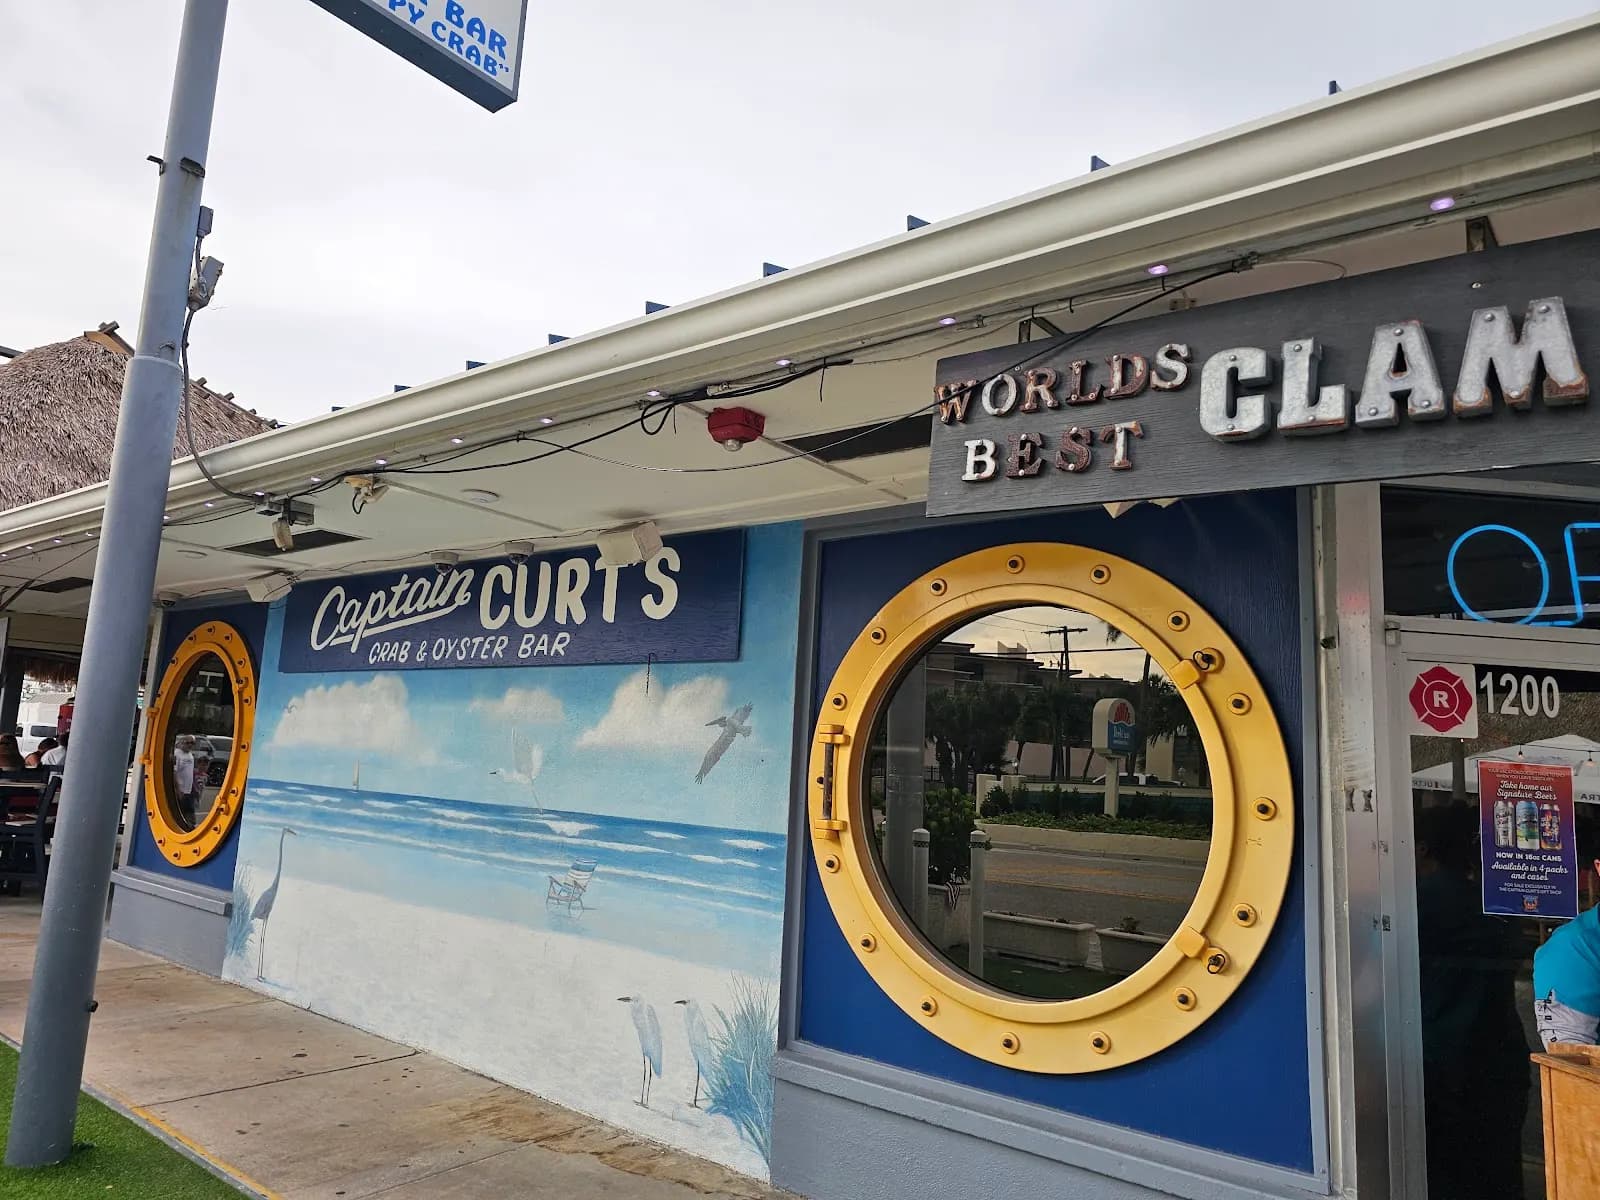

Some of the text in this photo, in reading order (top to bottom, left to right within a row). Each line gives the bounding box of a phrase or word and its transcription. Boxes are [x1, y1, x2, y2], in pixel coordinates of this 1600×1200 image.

[445, 0, 507, 60] BAR
[934, 296, 1590, 442] WORLDS CLAM
[961, 421, 1145, 482] BEST
[310, 546, 682, 654] Captain CURTS
[368, 631, 572, 665] CRAB & OYSTER BAR
[1433, 690, 1449, 708] R
[1480, 671, 1560, 718] 1200
[1497, 788, 1557, 800] Signature Beers
[1500, 780, 1518, 789] Take
[1519, 781, 1539, 790] home
[1491, 861, 1529, 872] Available
[1495, 851, 1513, 859] NOW
[1515, 852, 1523, 860] IN
[1541, 854, 1562, 862] CANS
[1511, 871, 1549, 881] and cases
